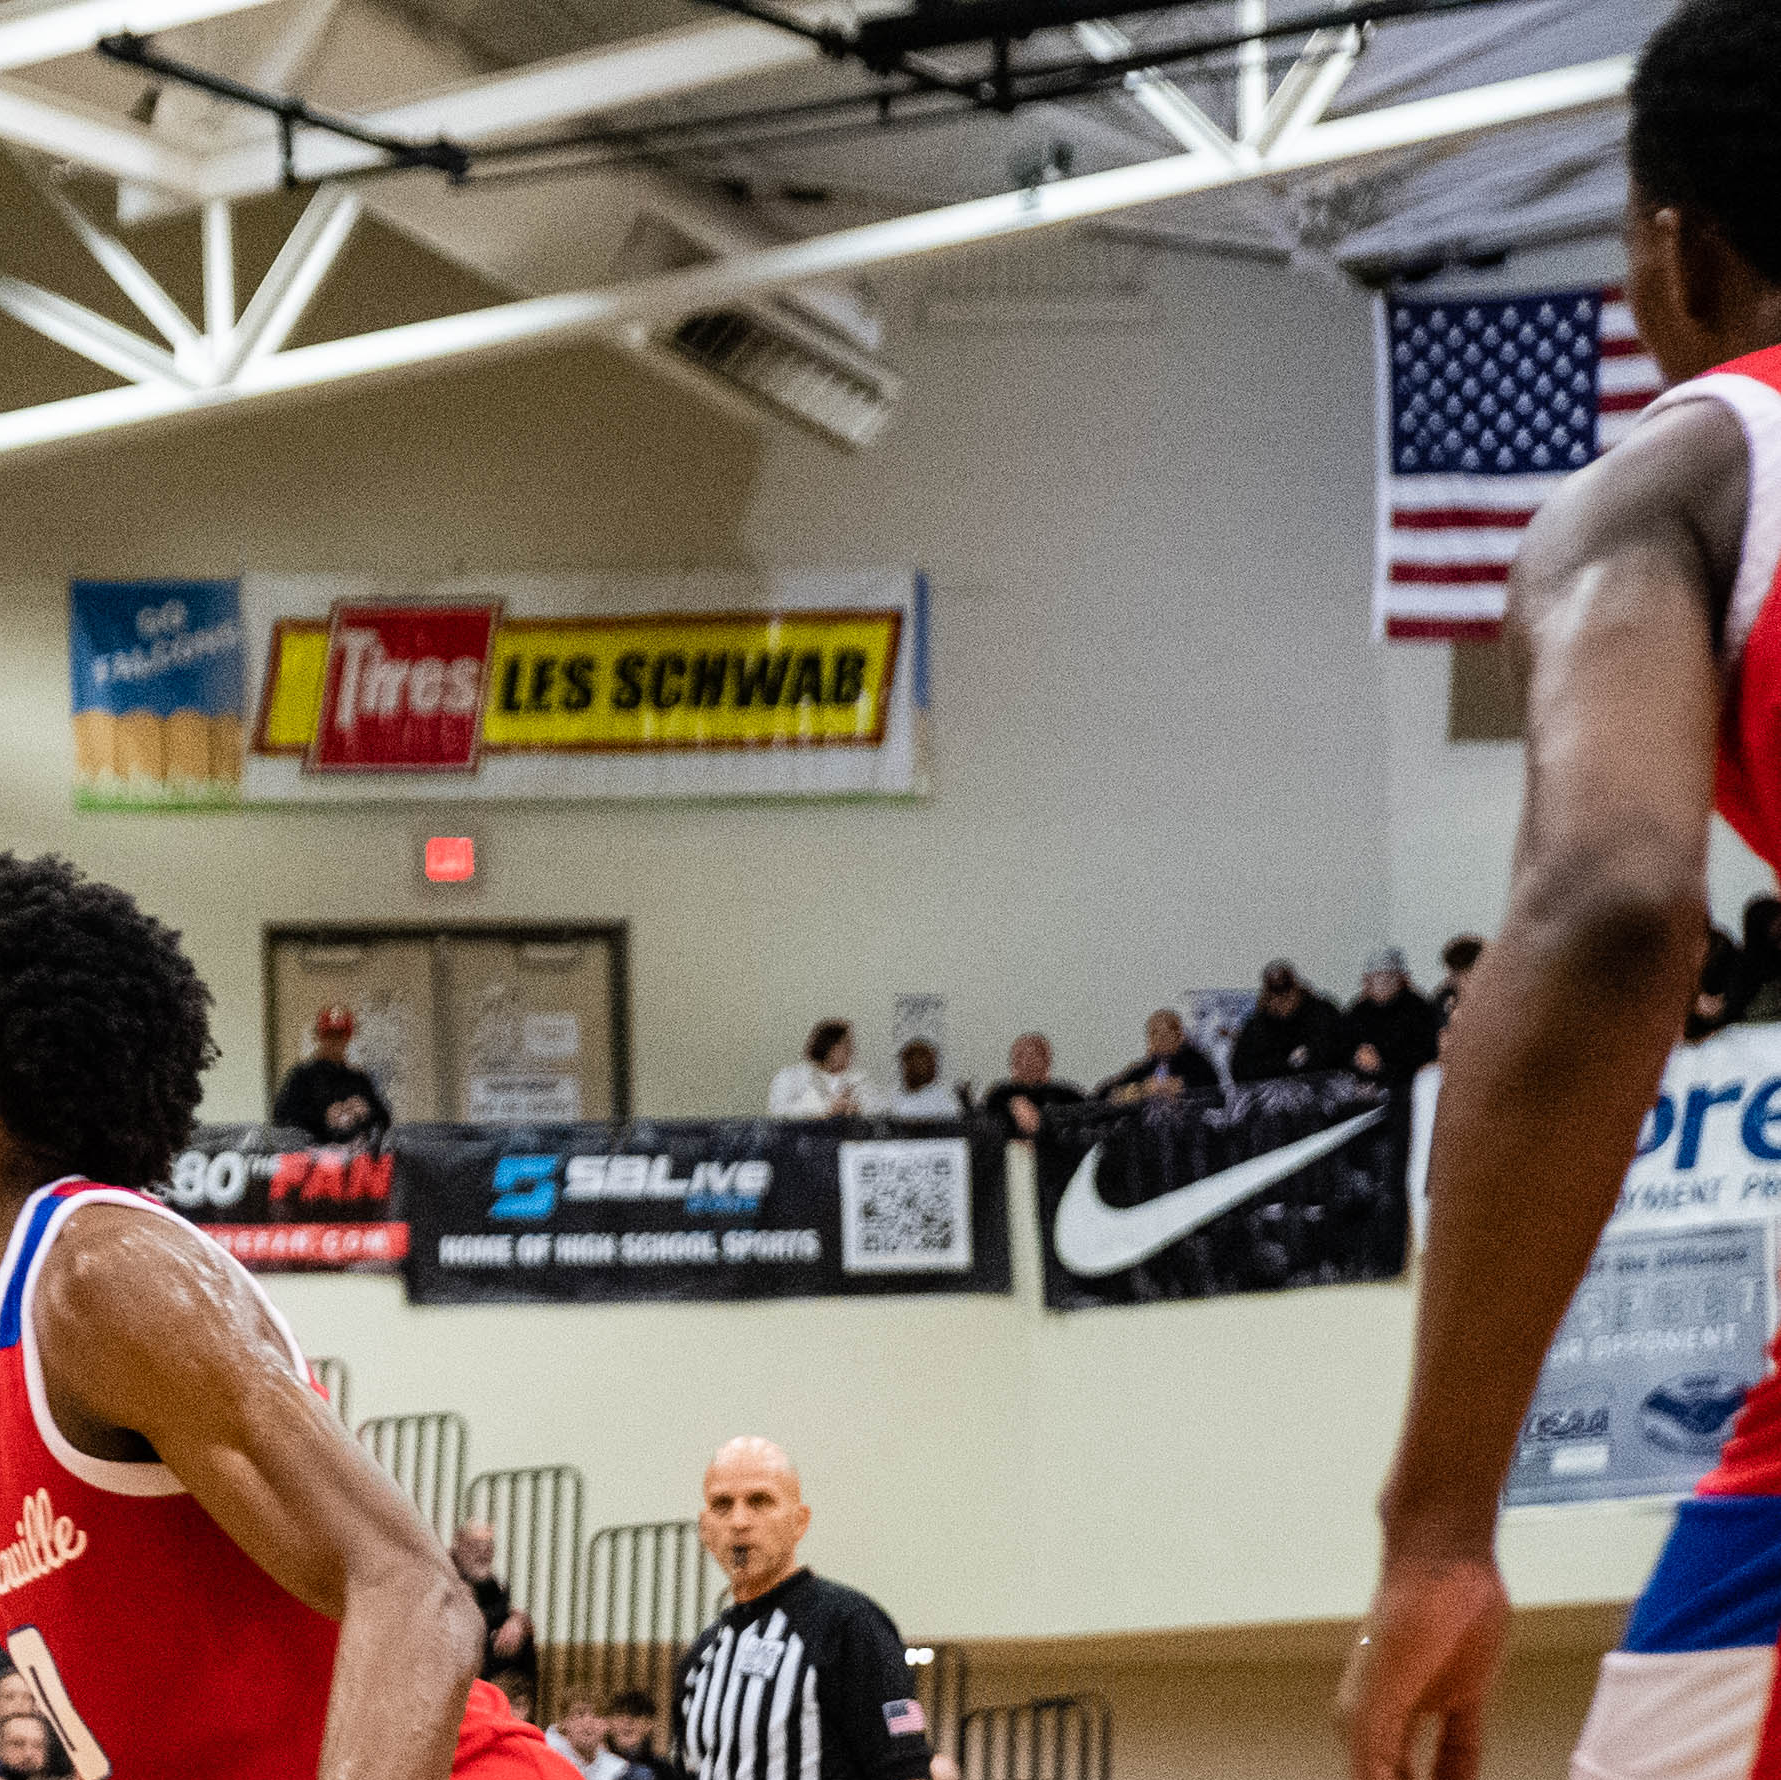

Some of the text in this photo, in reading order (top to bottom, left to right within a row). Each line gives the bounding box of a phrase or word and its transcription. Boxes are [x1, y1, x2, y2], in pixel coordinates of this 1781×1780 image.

[334, 628, 481, 730] Tires
[501, 646, 870, 715] LES SCHWAB
[153, 1150, 248, 1208] 80
[268, 1151, 395, 1201] FAN
[438, 1229, 823, 1267] HOME OF HIGH SCHOOL SPORTS
